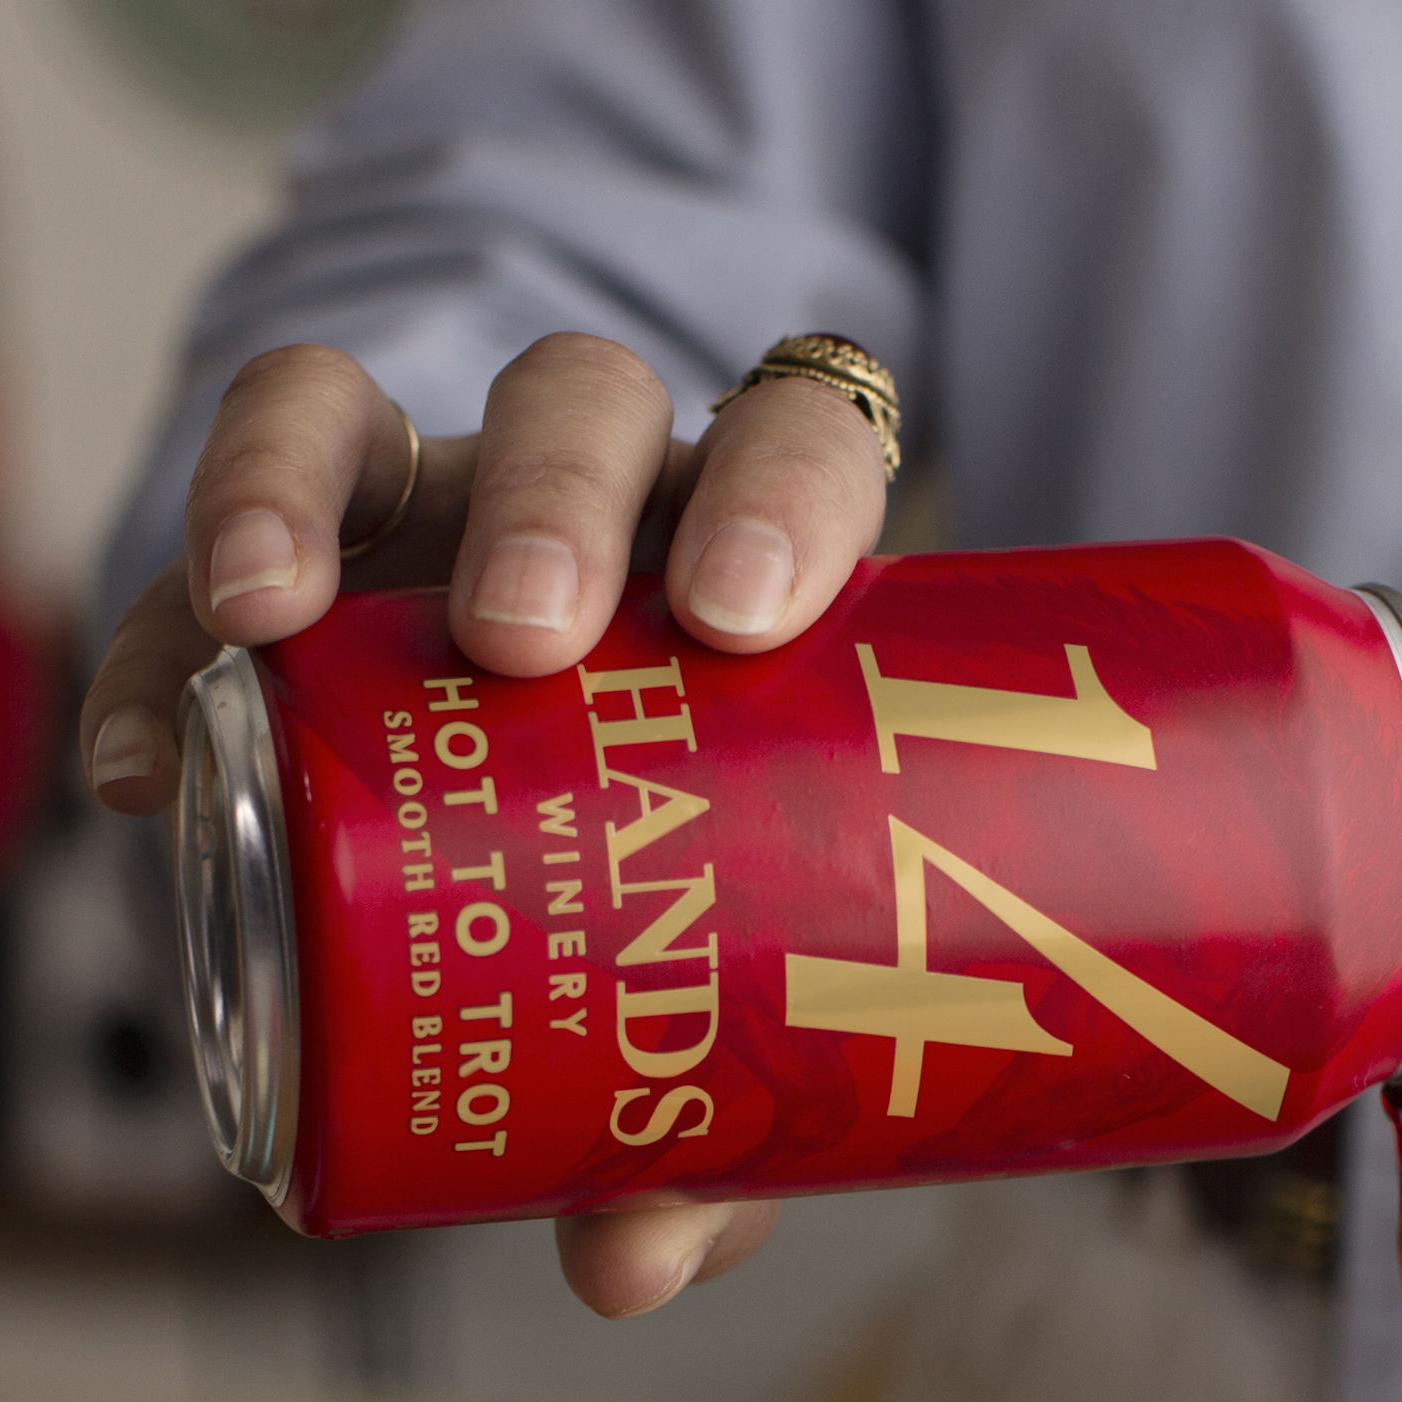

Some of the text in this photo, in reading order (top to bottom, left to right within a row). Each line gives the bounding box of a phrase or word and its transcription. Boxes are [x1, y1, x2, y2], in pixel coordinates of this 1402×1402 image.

[383, 710, 443, 1136] SMOOTH RED BLEND
[422, 676, 513, 1157] HOT TO TROT
[535, 792, 588, 1037] WINERY
[577, 655, 719, 1147] HANDS
[785, 642, 1291, 1122] 14
